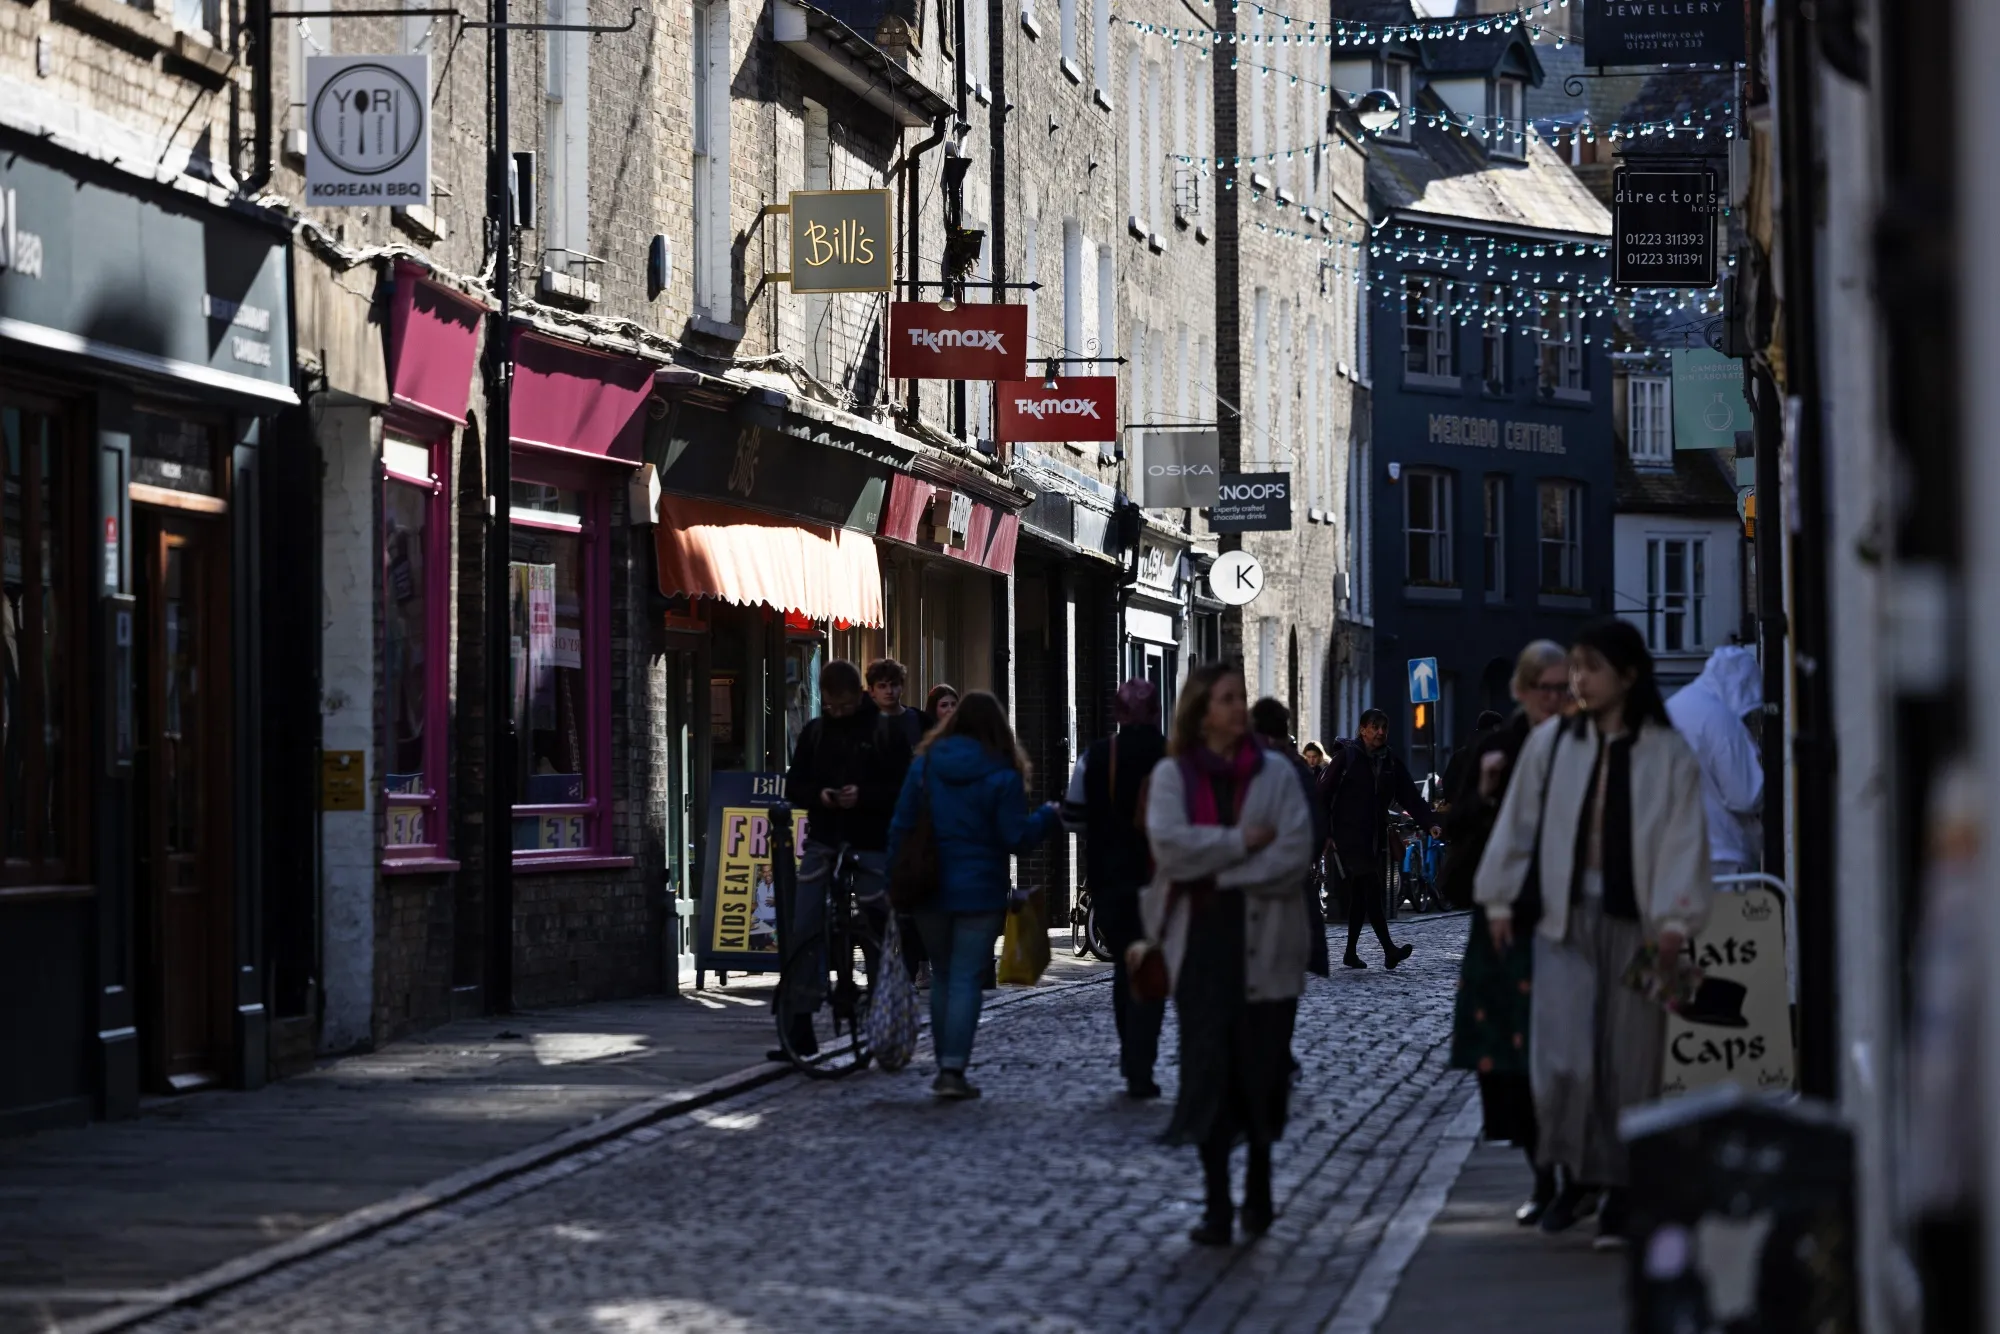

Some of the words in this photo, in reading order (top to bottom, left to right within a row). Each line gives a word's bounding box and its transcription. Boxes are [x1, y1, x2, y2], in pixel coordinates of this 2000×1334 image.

[1605, 2, 1722, 17] JEWELLERY
[312, 183, 383, 197] KOREAN
[386, 183, 422, 198] BBQ
[1615, 189, 1717, 204] directors
[803, 219, 875, 267] Bill's
[1625, 233, 1662, 245] 01223
[1664, 233, 1704, 245] 311393
[1627, 253, 1663, 265] 01223
[1666, 253, 1703, 265] 311391
[1428, 413, 1499, 448] MERCADO
[1503, 420, 1567, 454] CENTRAL
[1147, 464, 1215, 477] OSKA
[1213, 505, 1240, 514] Expertly
[1241, 504, 1265, 512] crafted
[1236, 564, 1255, 589] K
[752, 774, 787, 799] Bill
[727, 814, 810, 859] FRE
[723, 861, 750, 895] EAT
[719, 902, 747, 948] KIDS
[1671, 1031, 1766, 1071] Caps
